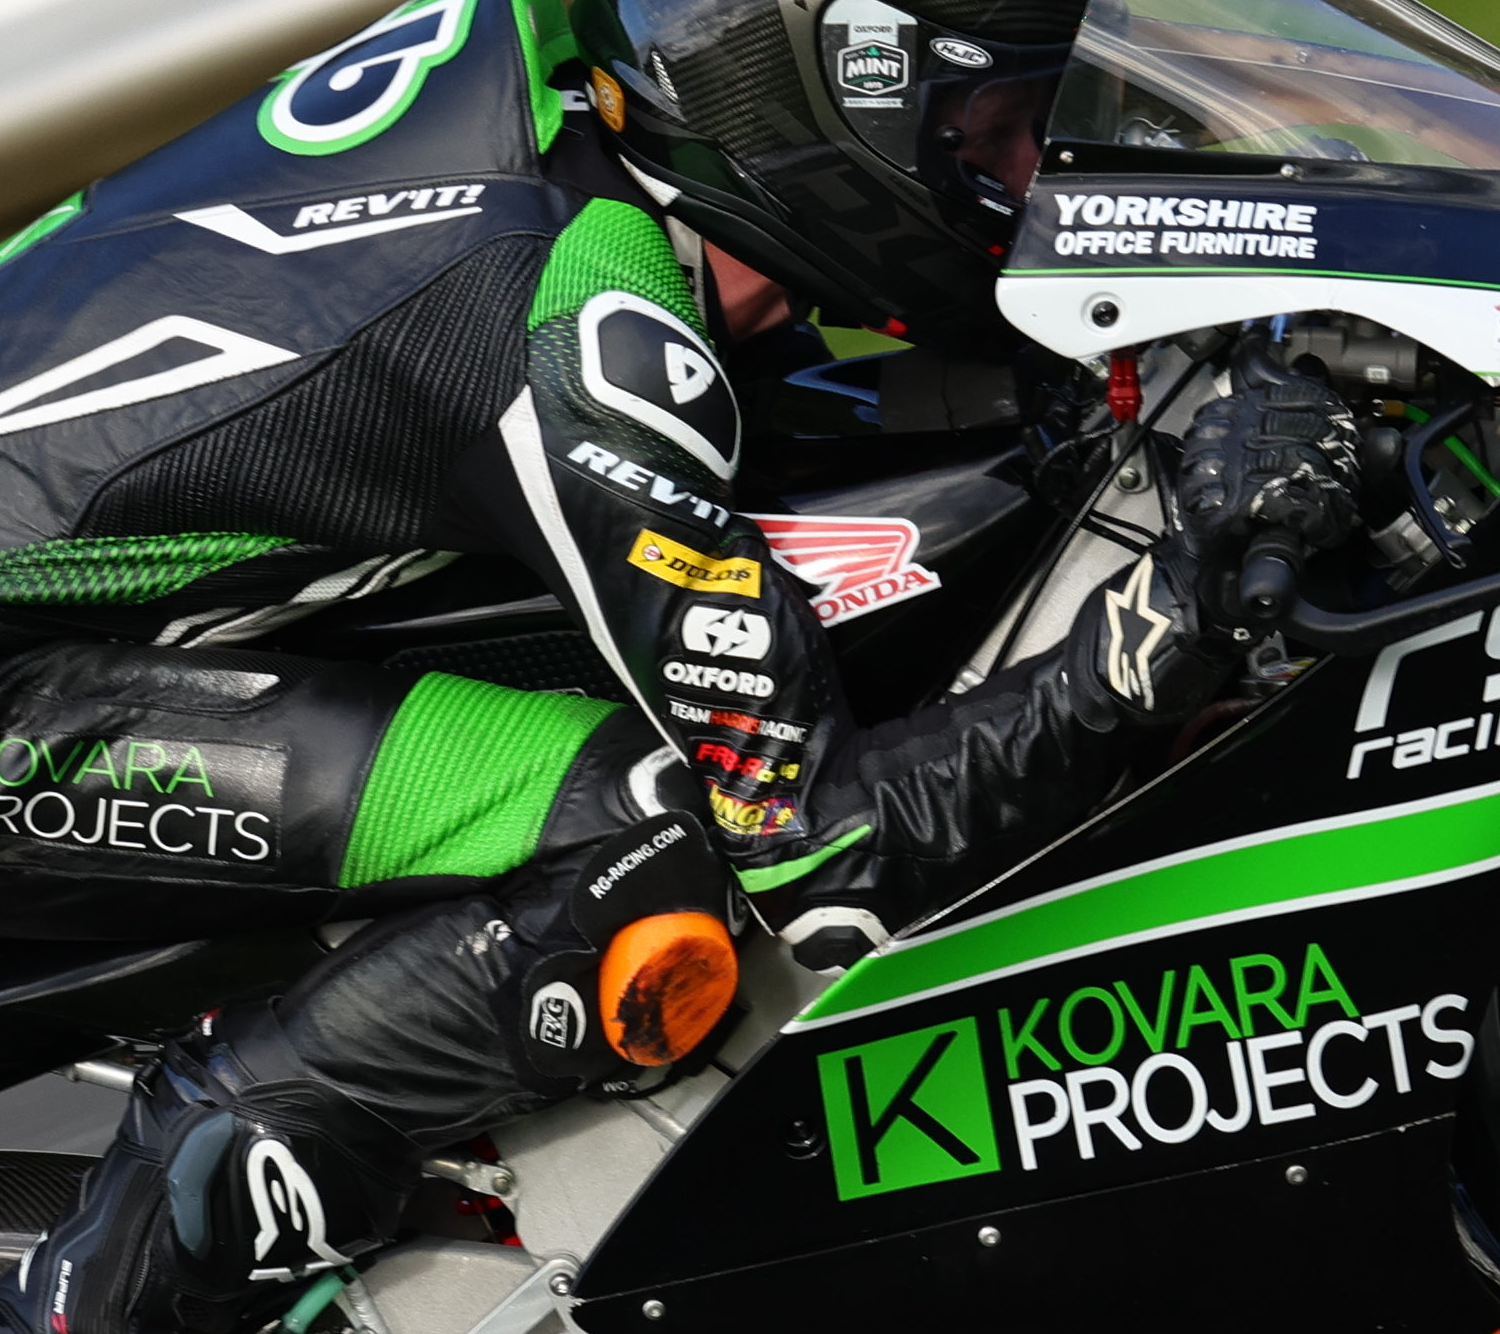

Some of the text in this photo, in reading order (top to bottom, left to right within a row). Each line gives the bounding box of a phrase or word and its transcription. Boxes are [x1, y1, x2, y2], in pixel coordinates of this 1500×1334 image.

[845, 57, 902, 79] MINT
[292, 183, 486, 229] REV'IT!
[1053, 193, 1318, 233] YORKSHIRE
[1054, 230, 1319, 259] OFFICE FURNITURE
[813, 569, 933, 621] ONDA
[663, 661, 775, 699] OXFORD
[588, 823, 688, 900] RG-RACING.COM
[998, 942, 1361, 1080] KOVARA
[1008, 994, 1475, 1172] PROJECTS
